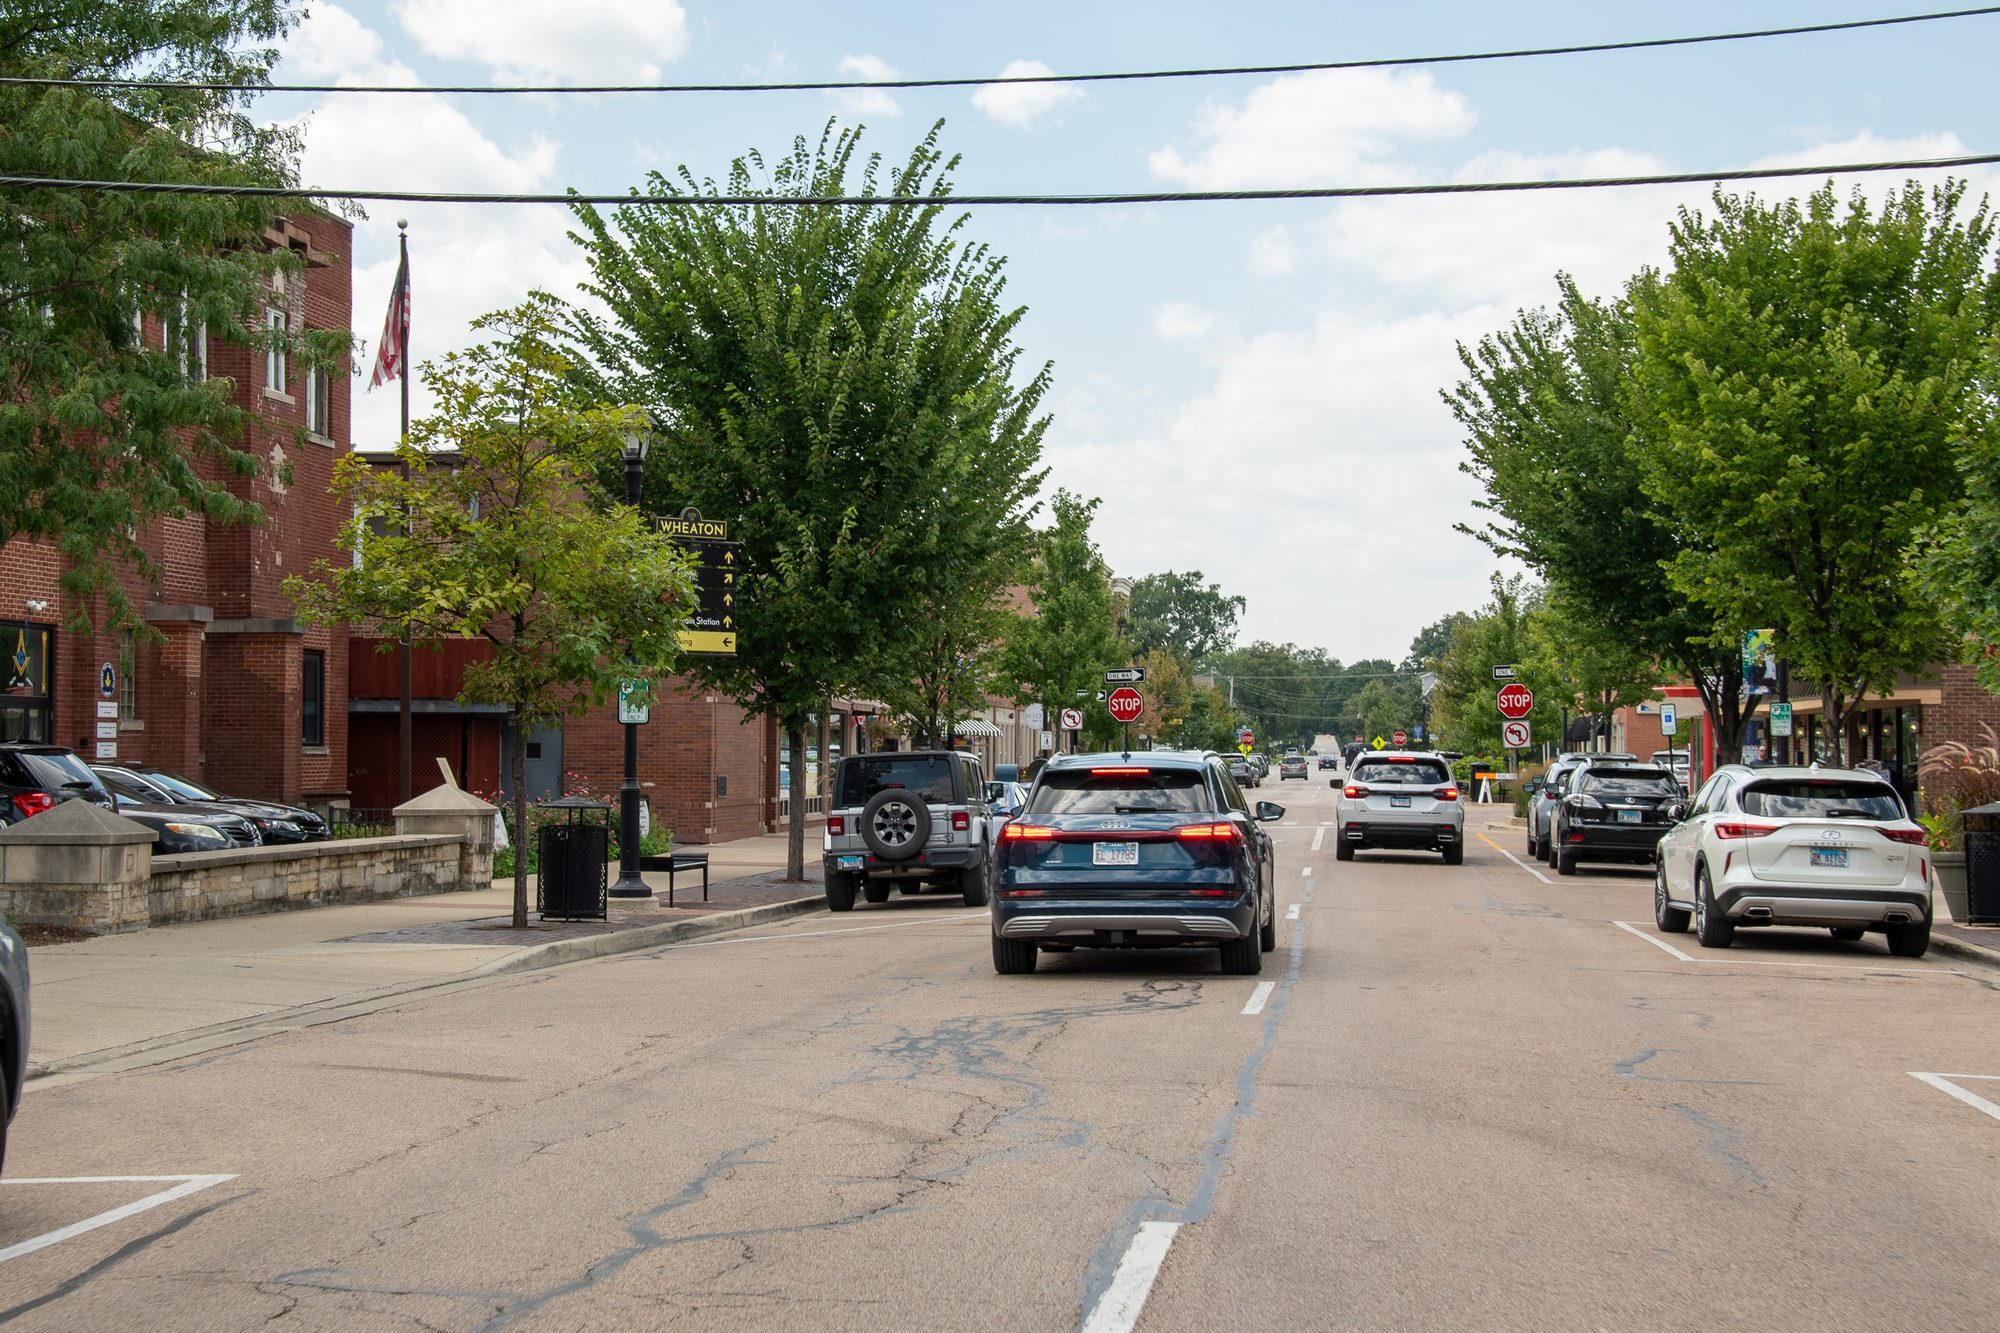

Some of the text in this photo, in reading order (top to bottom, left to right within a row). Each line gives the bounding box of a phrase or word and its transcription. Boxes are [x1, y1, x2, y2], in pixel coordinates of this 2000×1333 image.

[660, 520, 724, 536] WHEATON
[696, 616, 720, 626] Station
[1111, 698, 1141, 711] STOP
[1500, 694, 1531, 708] STOP
